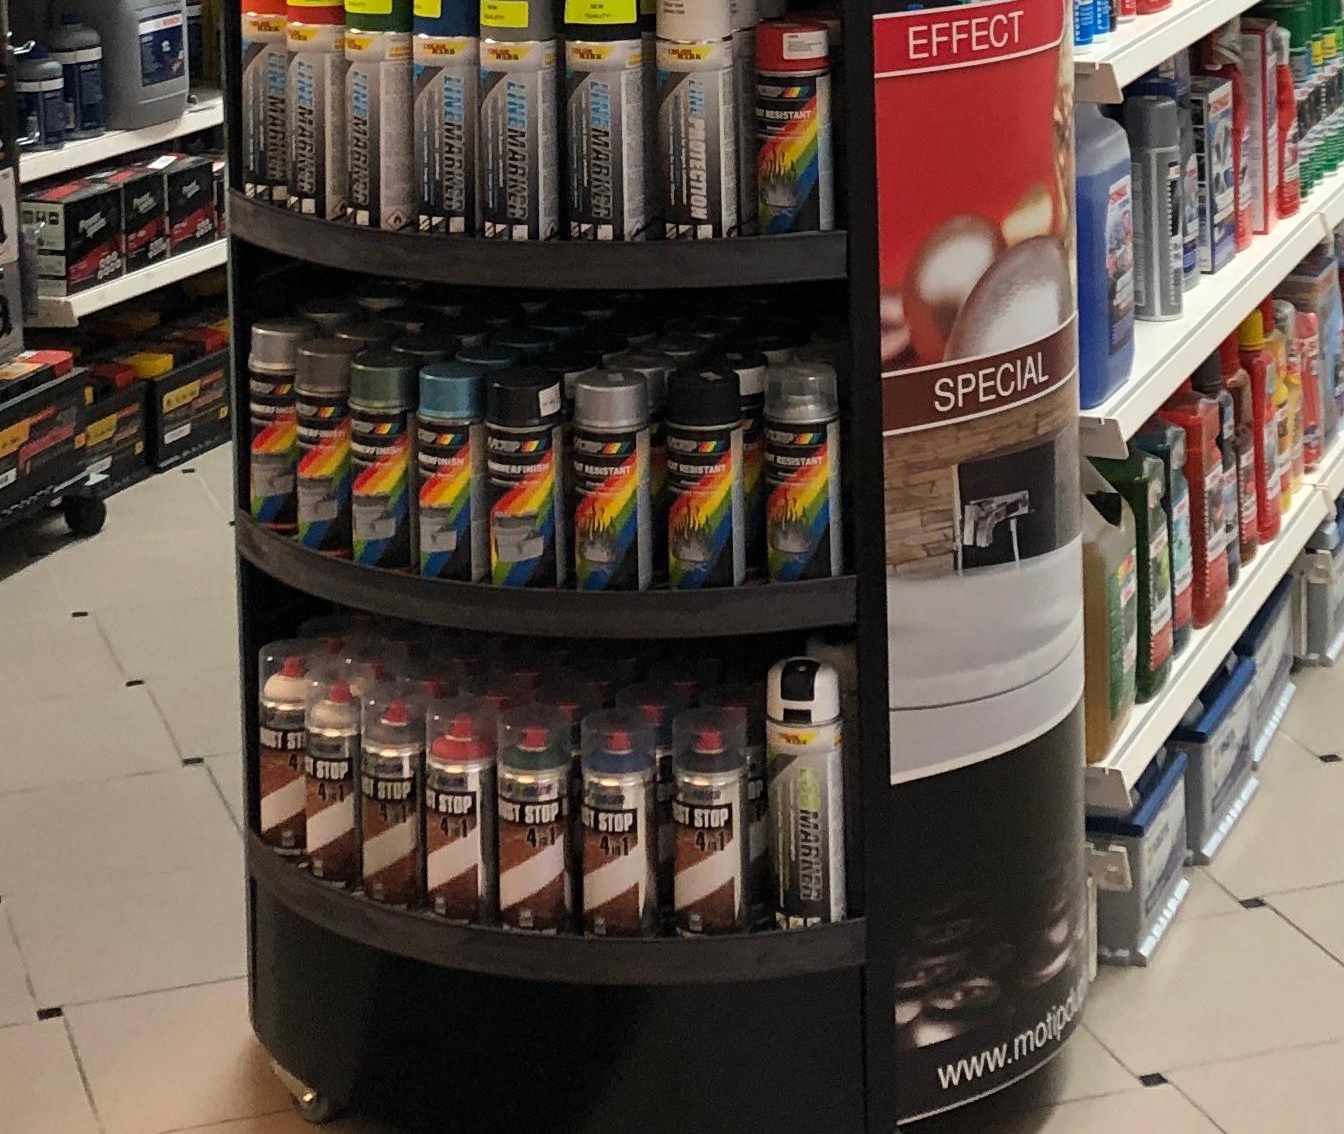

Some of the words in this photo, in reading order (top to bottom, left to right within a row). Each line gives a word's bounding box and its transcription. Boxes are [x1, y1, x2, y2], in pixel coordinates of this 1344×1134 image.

[908, 10, 1024, 60] EFFECT
[934, 351, 1049, 412] SPECIAL
[315, 760, 348, 779] STOP
[438, 795, 472, 813] STOP
[525, 803, 558, 823] STOP
[598, 812, 633, 832] STOP
[694, 808, 728, 828] STOP
